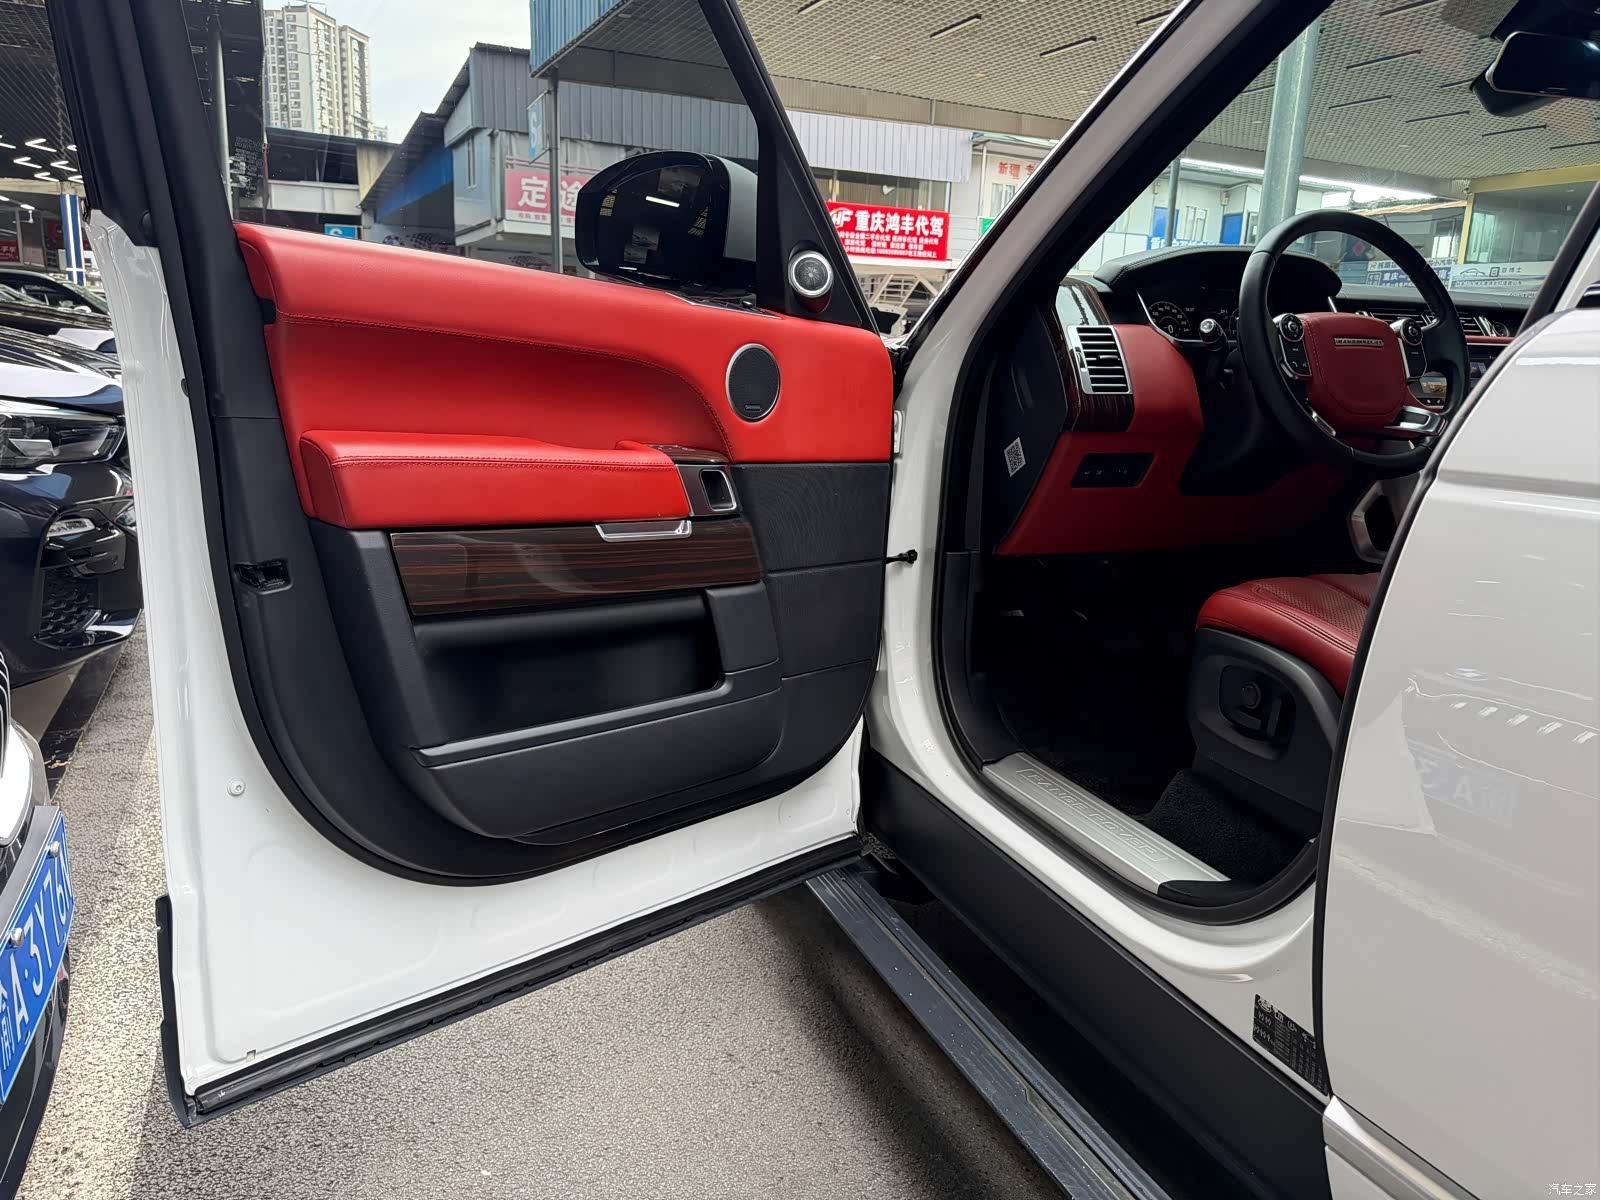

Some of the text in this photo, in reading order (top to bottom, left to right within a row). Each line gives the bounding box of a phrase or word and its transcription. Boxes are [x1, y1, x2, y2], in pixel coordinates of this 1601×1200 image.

[855, 210, 945, 237] 重庆鸿丰代驾
